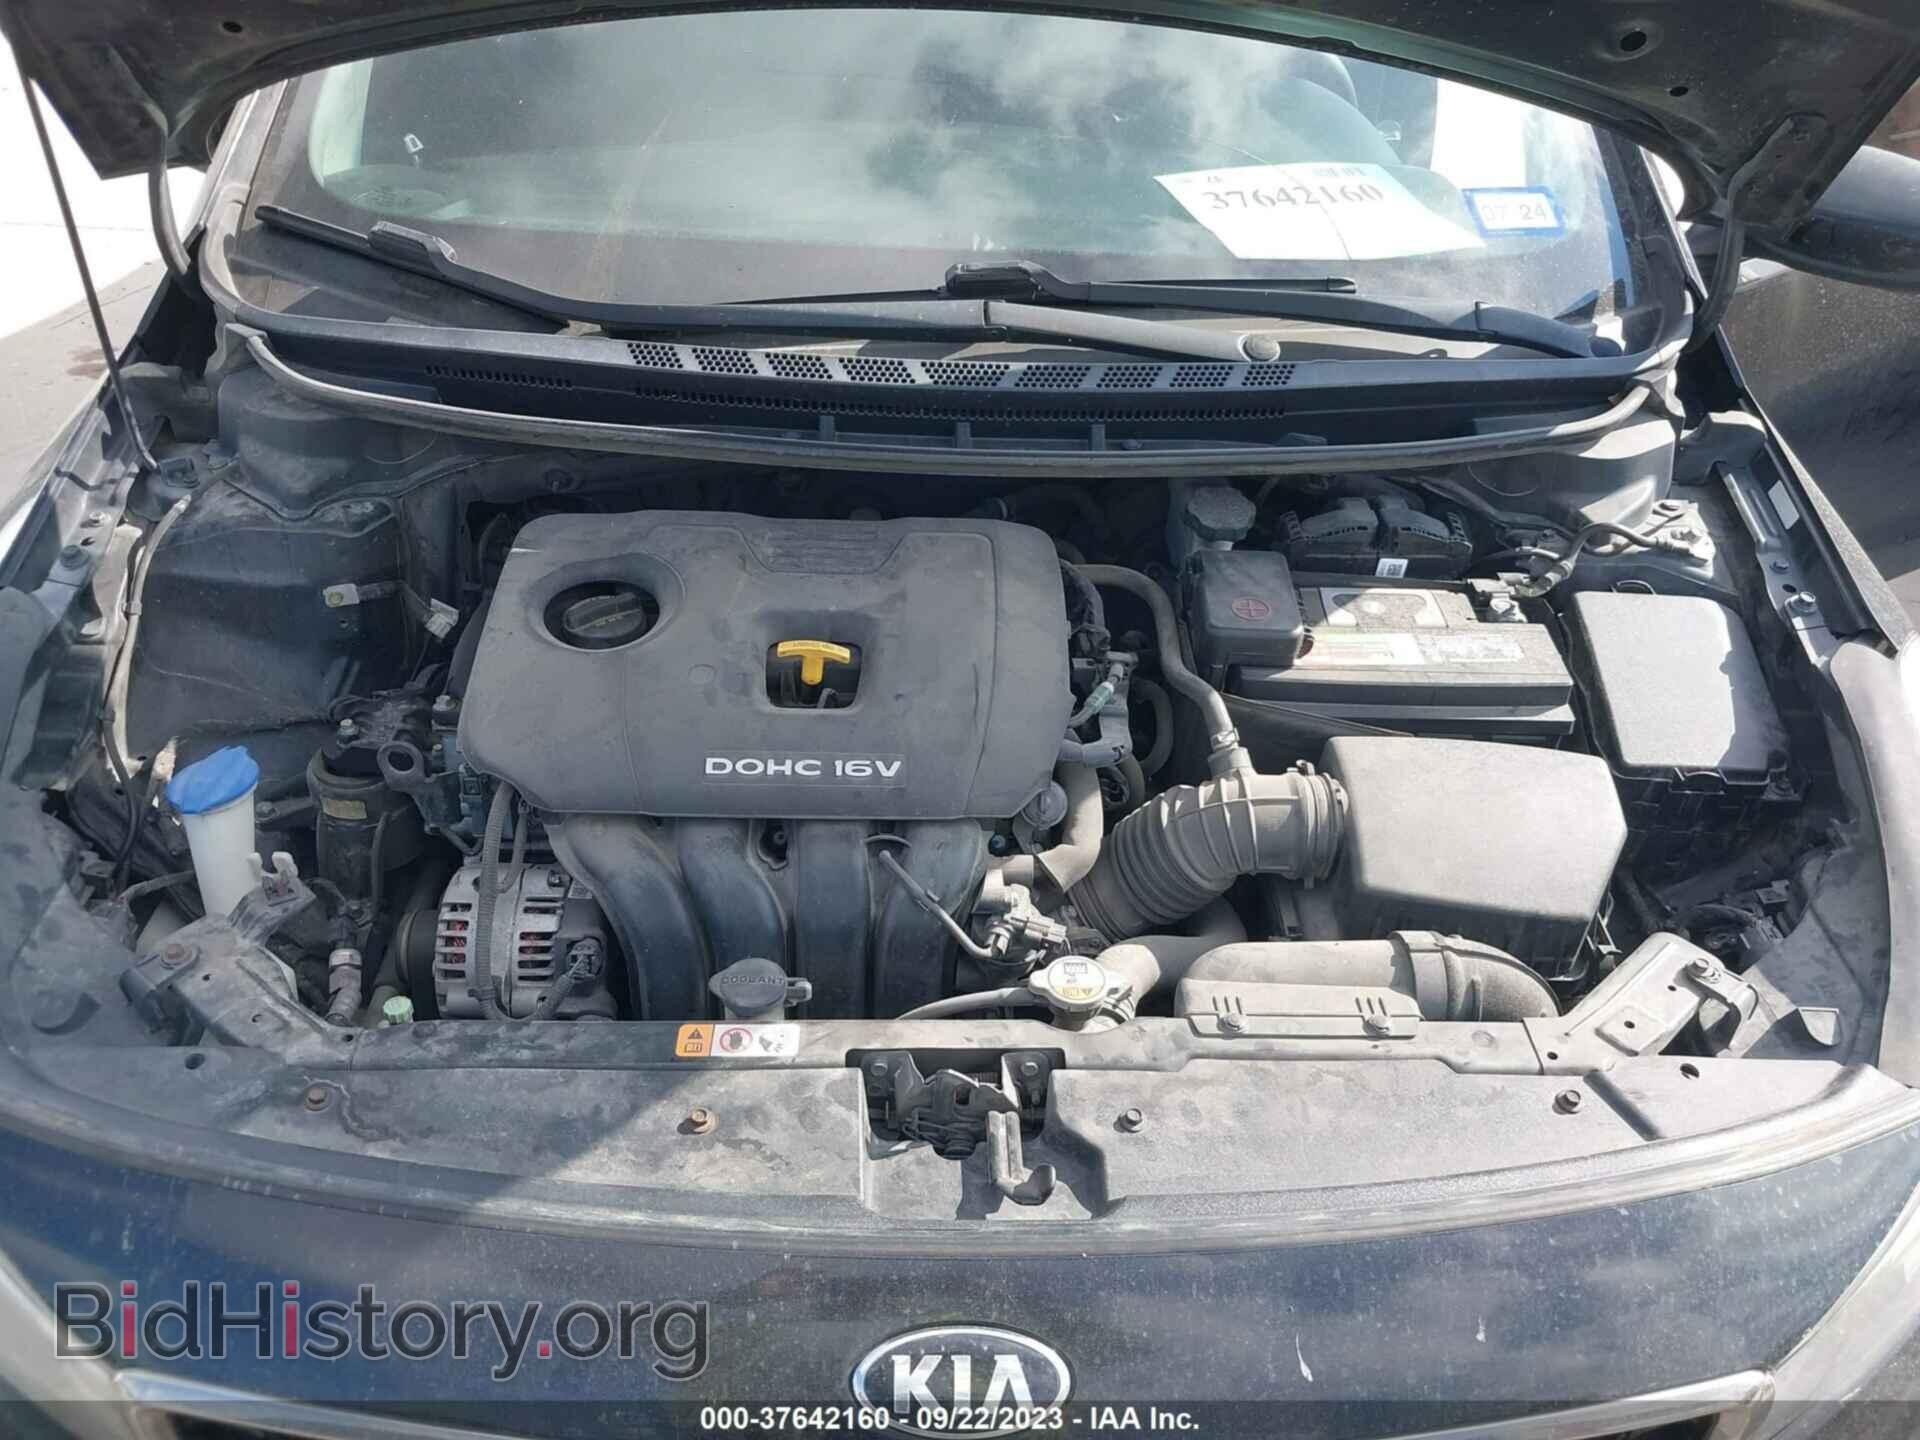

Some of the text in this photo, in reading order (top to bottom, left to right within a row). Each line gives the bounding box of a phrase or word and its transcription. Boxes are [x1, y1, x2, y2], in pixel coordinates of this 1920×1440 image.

[1202, 183, 1384, 209] 37642160
[1519, 203, 1548, 221] 24
[705, 757, 902, 777] DOHC 16V
[721, 975, 785, 985] COOLANT
[891, 1354, 1035, 1414] KIA
